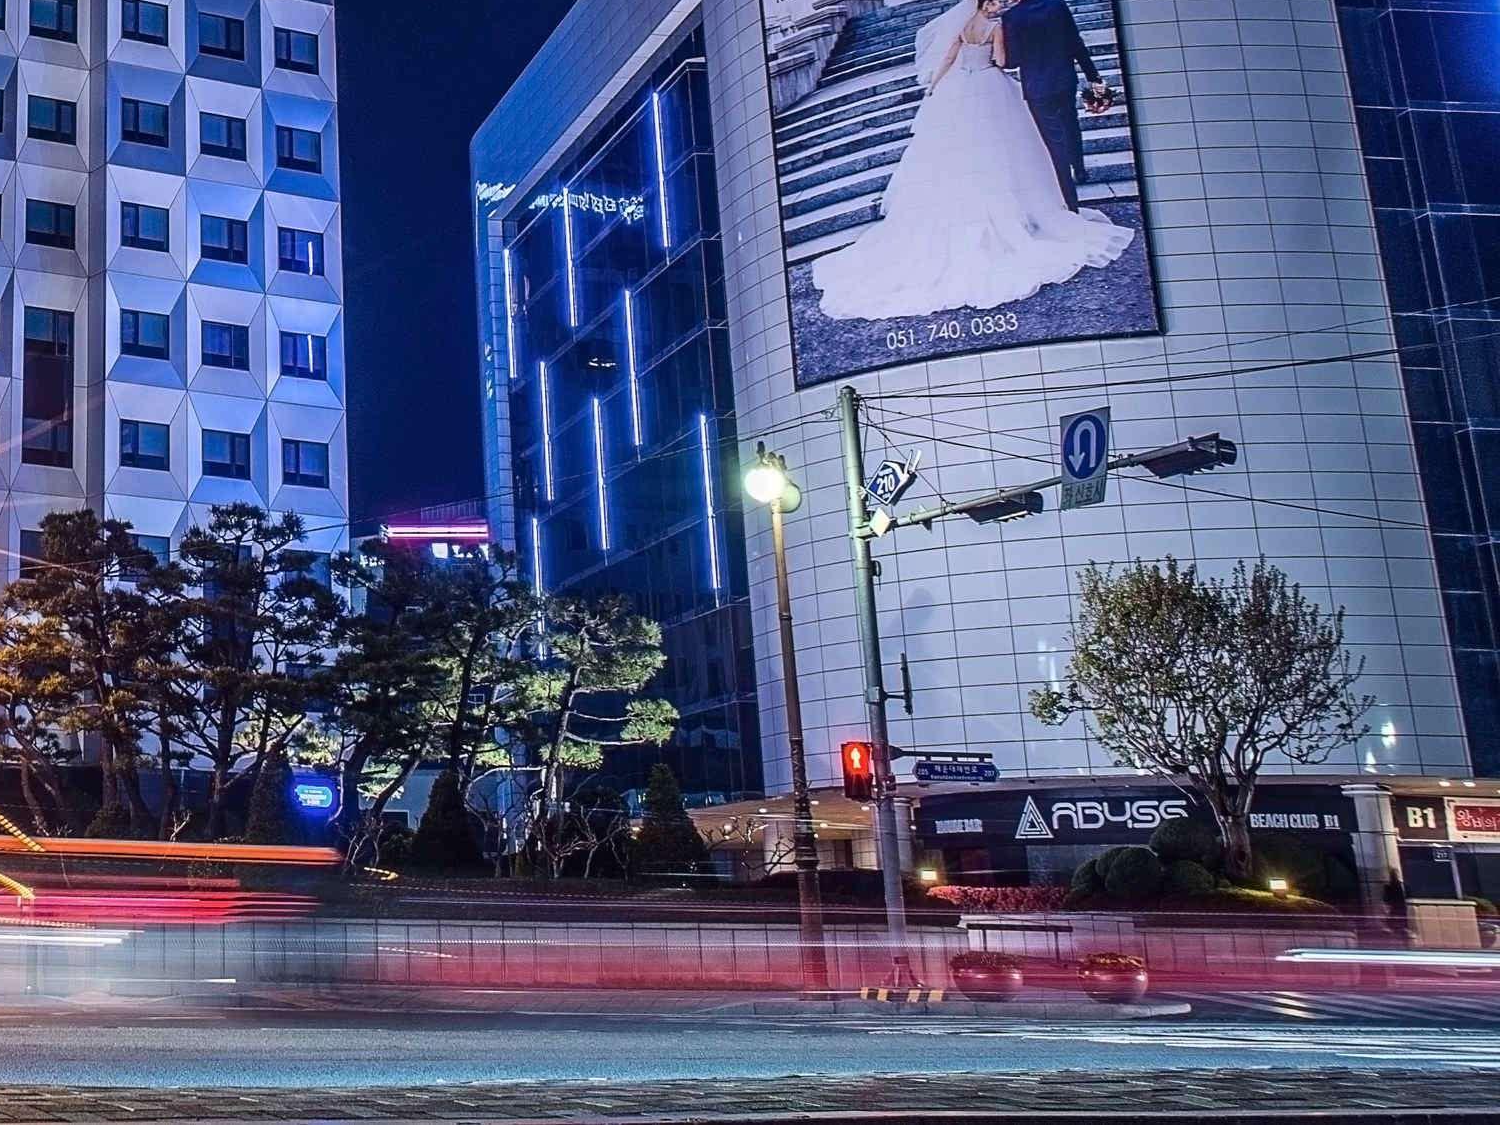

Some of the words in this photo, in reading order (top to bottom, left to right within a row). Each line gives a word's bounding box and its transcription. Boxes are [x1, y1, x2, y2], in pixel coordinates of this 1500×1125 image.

[971, 313, 1019, 335] 0333
[876, 474, 896, 495] 210
[1051, 799, 1189, 830] ABYSS
[1250, 813, 1288, 828] BEACH
[1289, 813, 1319, 829] CLUB
[1323, 814, 1340, 829] B1
[1406, 806, 1437, 829] B1
